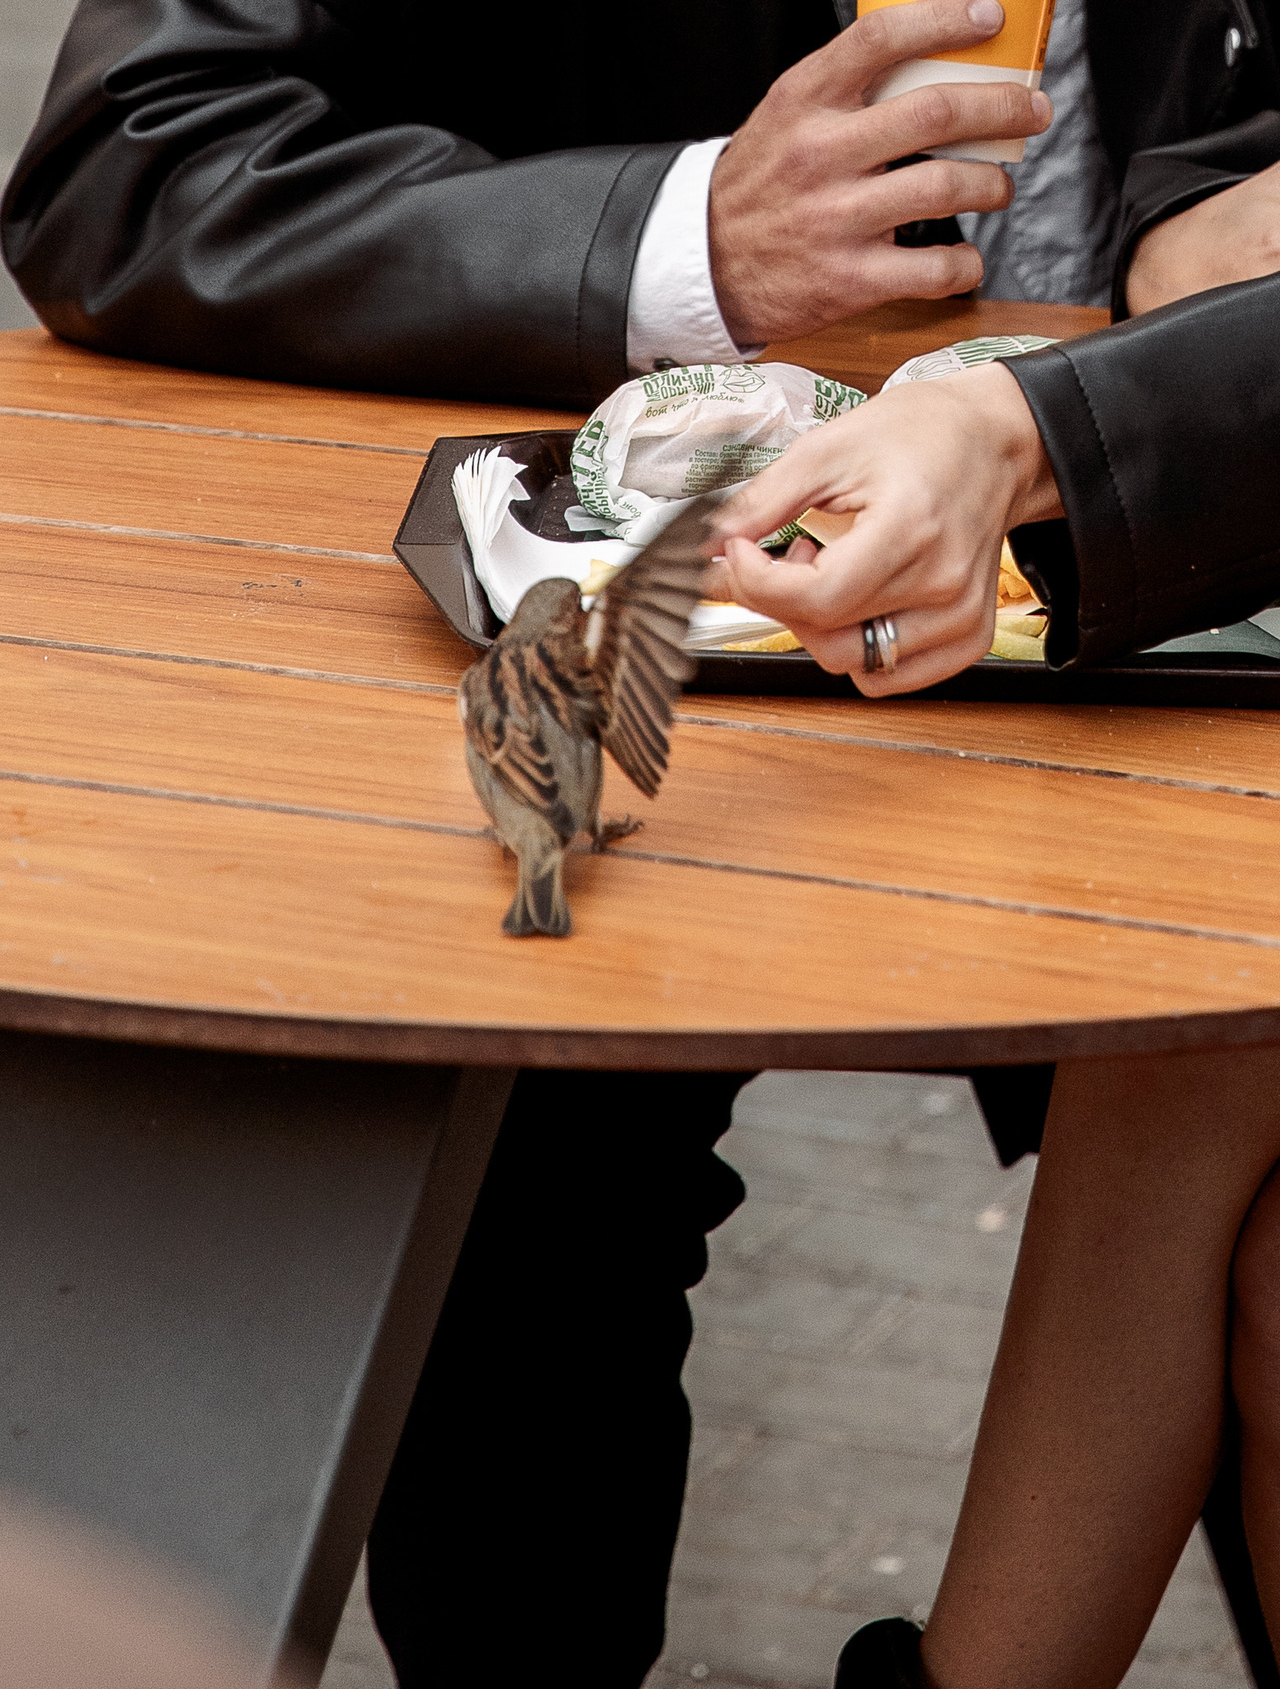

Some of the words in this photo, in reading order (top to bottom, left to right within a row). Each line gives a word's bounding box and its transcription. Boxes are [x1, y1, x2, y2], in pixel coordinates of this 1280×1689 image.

[643, 372, 715, 397] ОТЛИЧНО
[645, 404, 668, 418] вот
[722, 443, 755, 452] СЭНДВИЧ
[756, 446, 786, 454] ЧИКЕН
